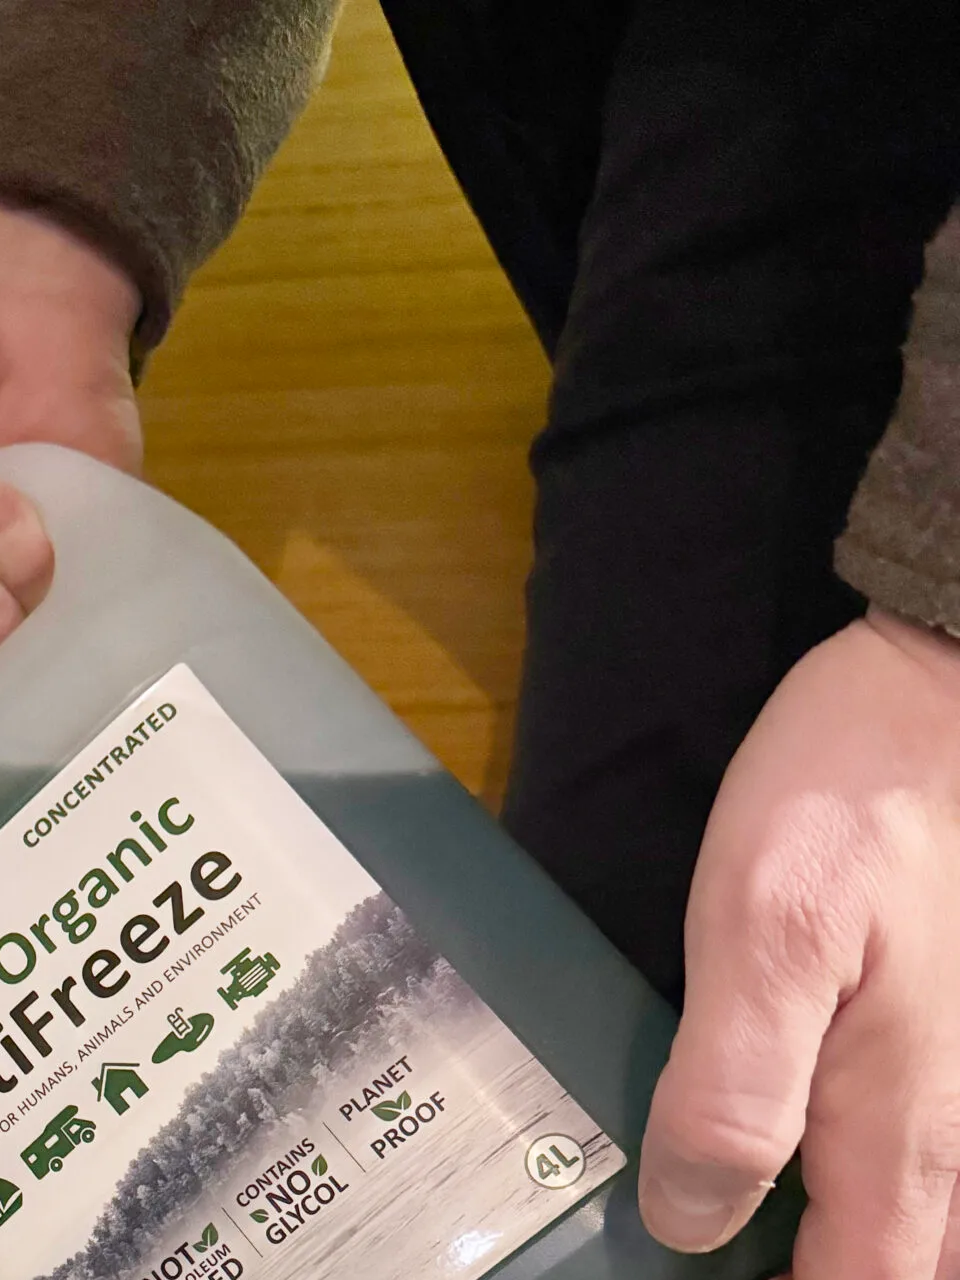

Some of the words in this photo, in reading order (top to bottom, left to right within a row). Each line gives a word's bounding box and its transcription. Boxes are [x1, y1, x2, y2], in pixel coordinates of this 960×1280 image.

[23, 702, 178, 848] CONCENTRATED
[20, 1061, 79, 1116] HUMANS,
[77, 1006, 135, 1062] ANIMALS
[134, 980, 164, 1010] AND
[163, 892, 262, 983] ENVIRONMENT
[339, 1055, 414, 1122] PLANET
[370, 1091, 446, 1160] PROOF
[236, 1137, 316, 1208] CONTAINS
[265, 1169, 312, 1213] NO
[535, 1144, 580, 1181] 4L
[265, 1175, 349, 1245] GLYCOL
